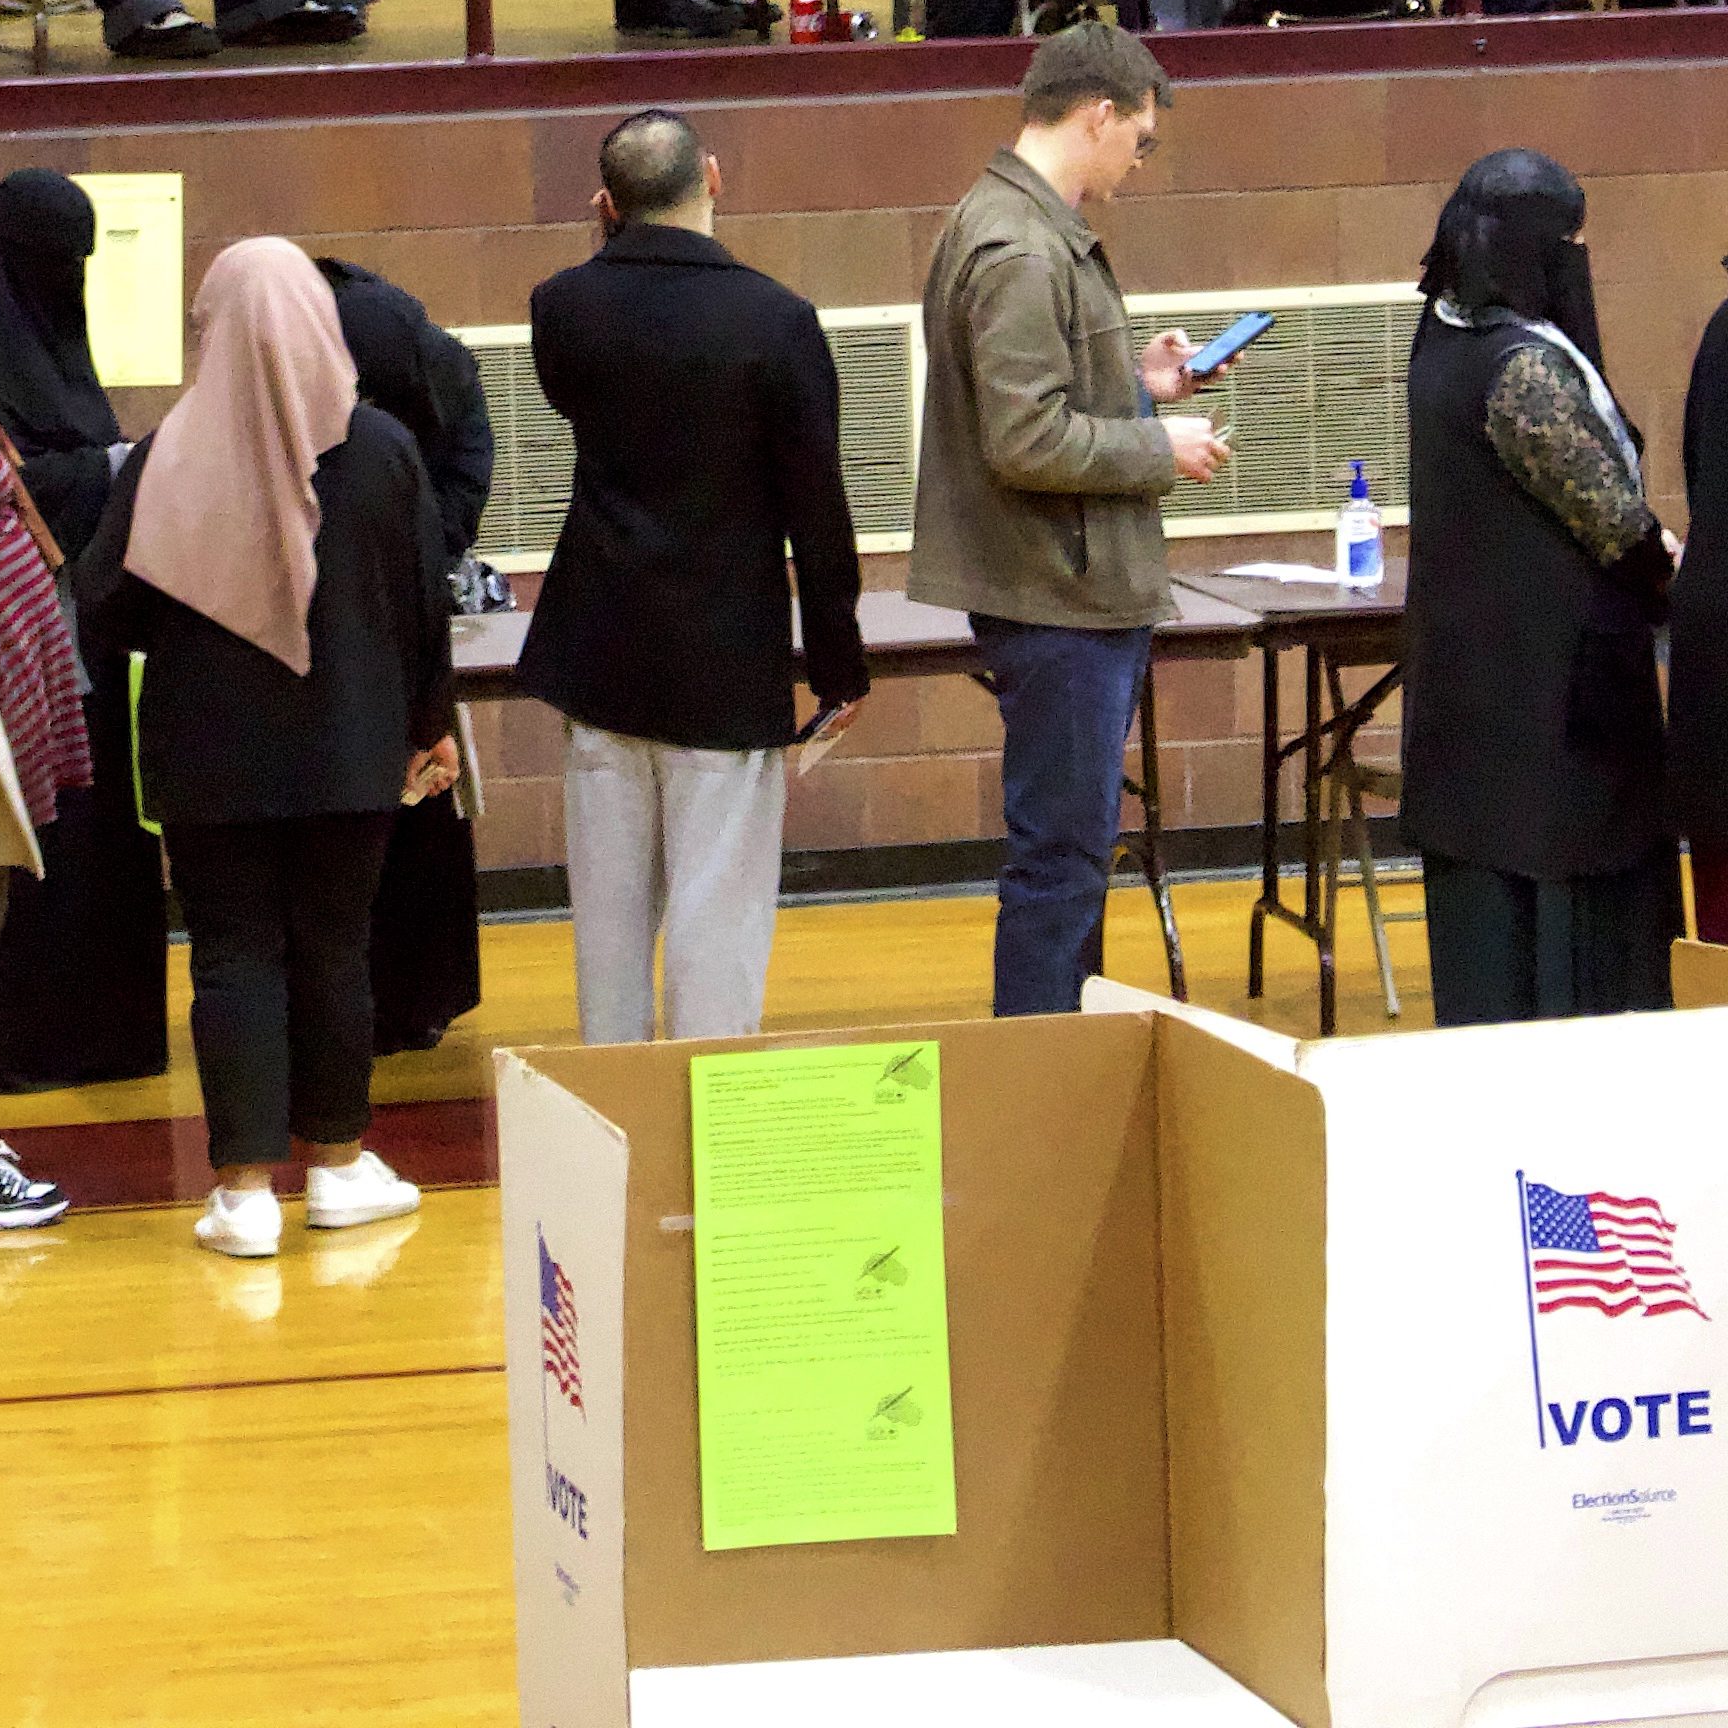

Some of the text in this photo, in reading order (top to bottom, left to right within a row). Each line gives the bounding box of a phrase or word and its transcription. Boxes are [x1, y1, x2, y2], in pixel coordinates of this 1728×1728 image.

[1548, 1390, 1712, 1446] VOTE
[546, 1462, 589, 1540] VOTE
[1572, 1487, 1678, 1509] ElectionSource
